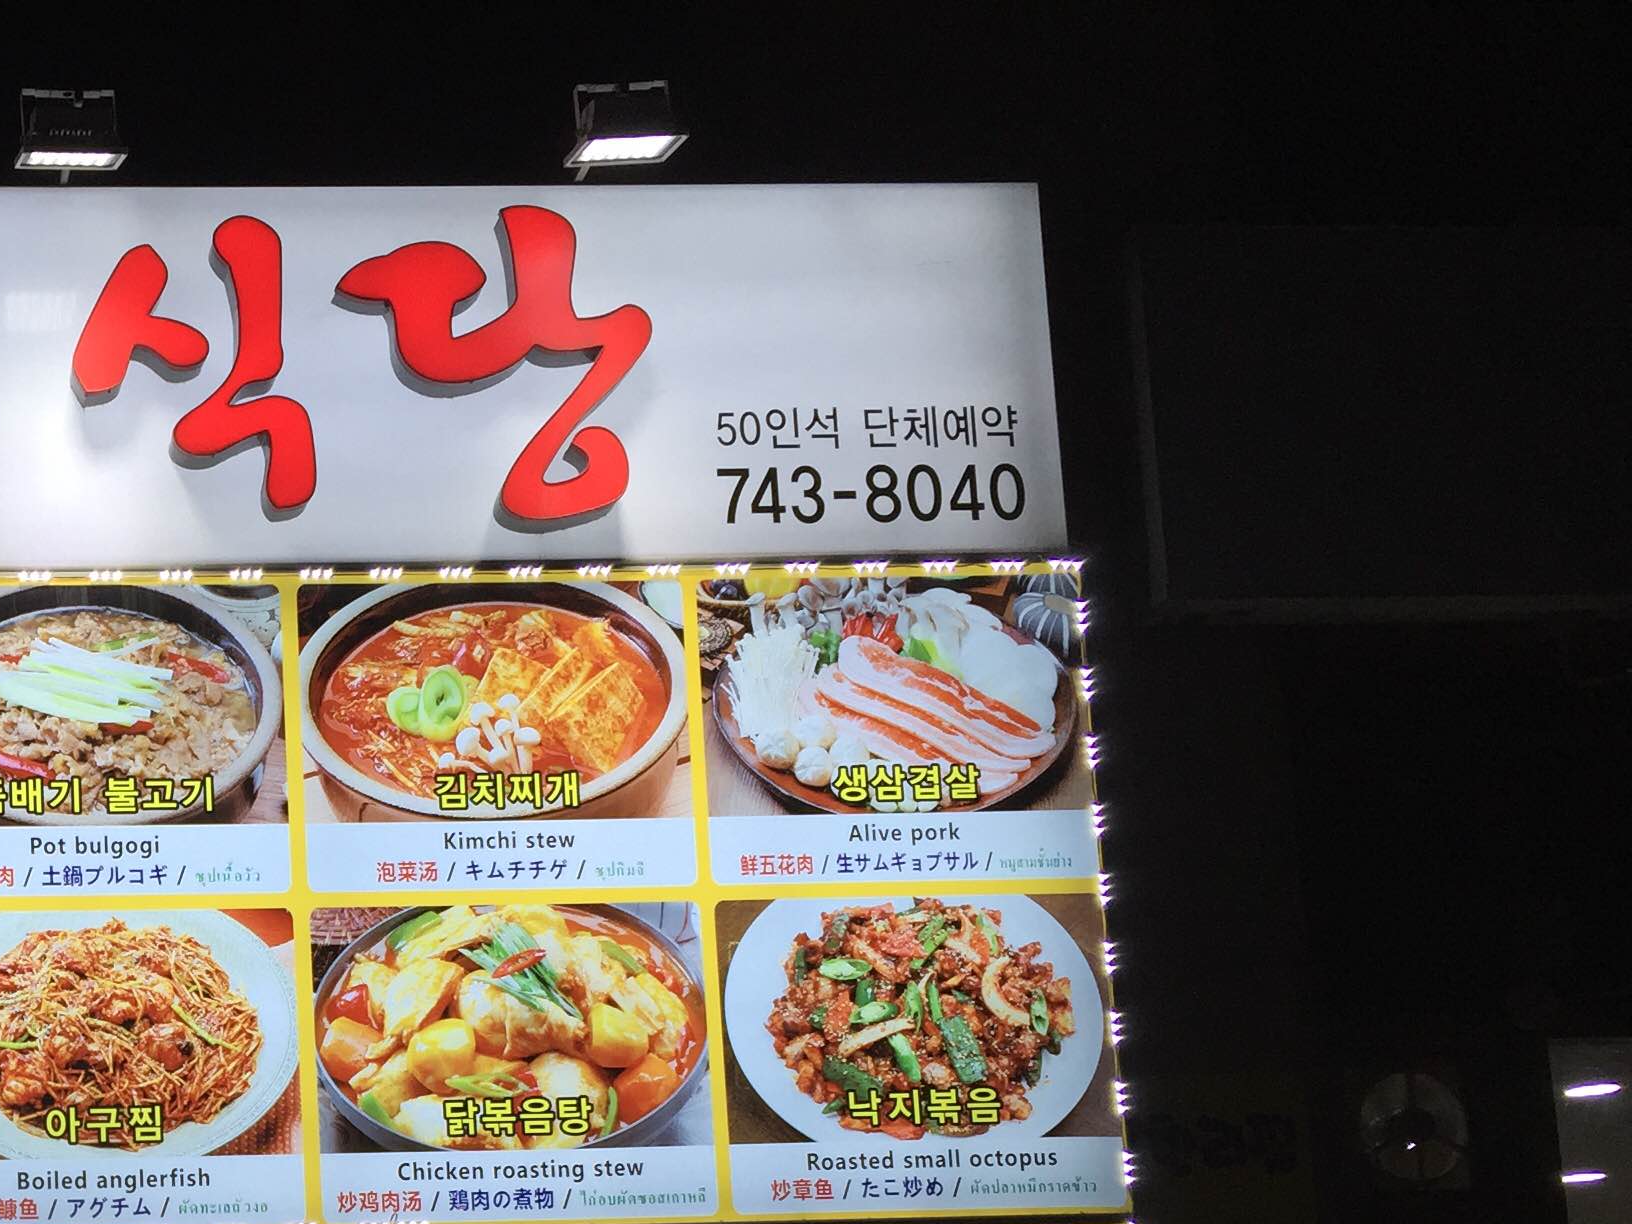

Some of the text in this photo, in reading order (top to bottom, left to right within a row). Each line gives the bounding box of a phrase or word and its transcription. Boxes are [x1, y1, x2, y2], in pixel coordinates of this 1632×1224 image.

[716, 403, 1019, 448] 50인석 단체예약
[716, 463, 1026, 524] 743-8040
[103, 776, 217, 815] 불고기
[433, 770, 582, 811] 김치찌개
[832, 762, 982, 804] 생삼겹살
[30, 835, 160, 858] Pot bulgogi
[443, 831, 576, 851] Kimchi stew
[849, 822, 960, 845] Alive pork
[375, 860, 439, 883] 泡菜汤
[464, 859, 568, 881] キムチチゲ
[739, 853, 814, 877] 鲜五花肉
[442, 1094, 593, 1138] 닭볶음탕
[845, 1087, 1002, 1127] 낙지볶음
[44, 1104, 165, 1145] 아구찜
[397, 1159, 644, 1182] Chicken roasting stew
[807, 1150, 1058, 1172] Roasted small octopus
[17, 1167, 211, 1193] Boiled anglerfish
[770, 1179, 834, 1202] 炒章鱼
[861, 1176, 943, 1198] たこ炒め
[68, 1198, 152, 1218] アグチム
[336, 1190, 422, 1213] 炒鸡肉汤
